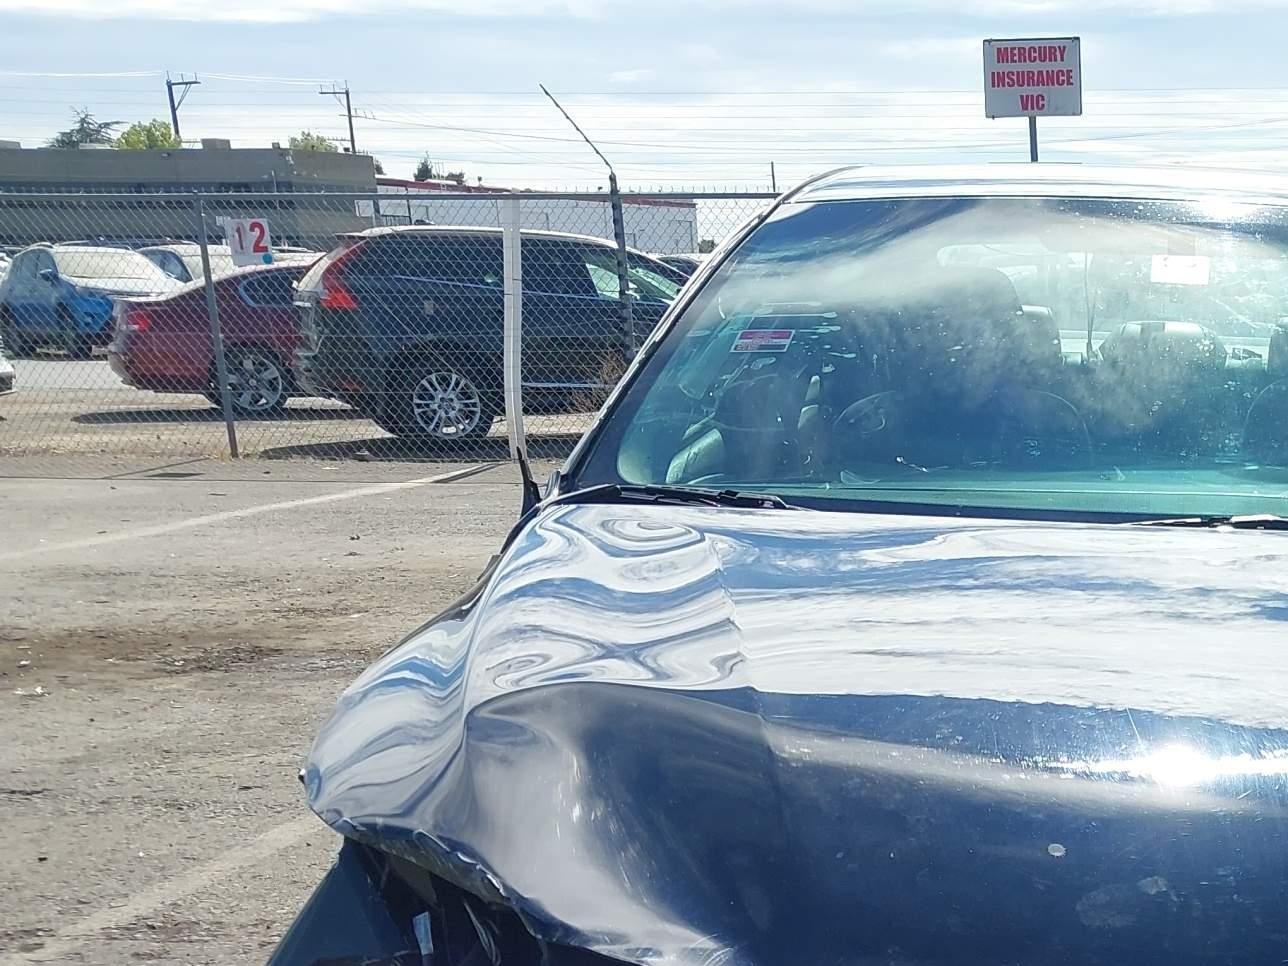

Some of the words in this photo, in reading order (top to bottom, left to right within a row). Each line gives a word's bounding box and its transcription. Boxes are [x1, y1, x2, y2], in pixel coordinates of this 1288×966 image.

[996, 45, 1067, 64] MERCURY
[991, 69, 1074, 88] INSURANCE
[1019, 94, 1046, 112] VIC
[235, 221, 269, 254] 12
